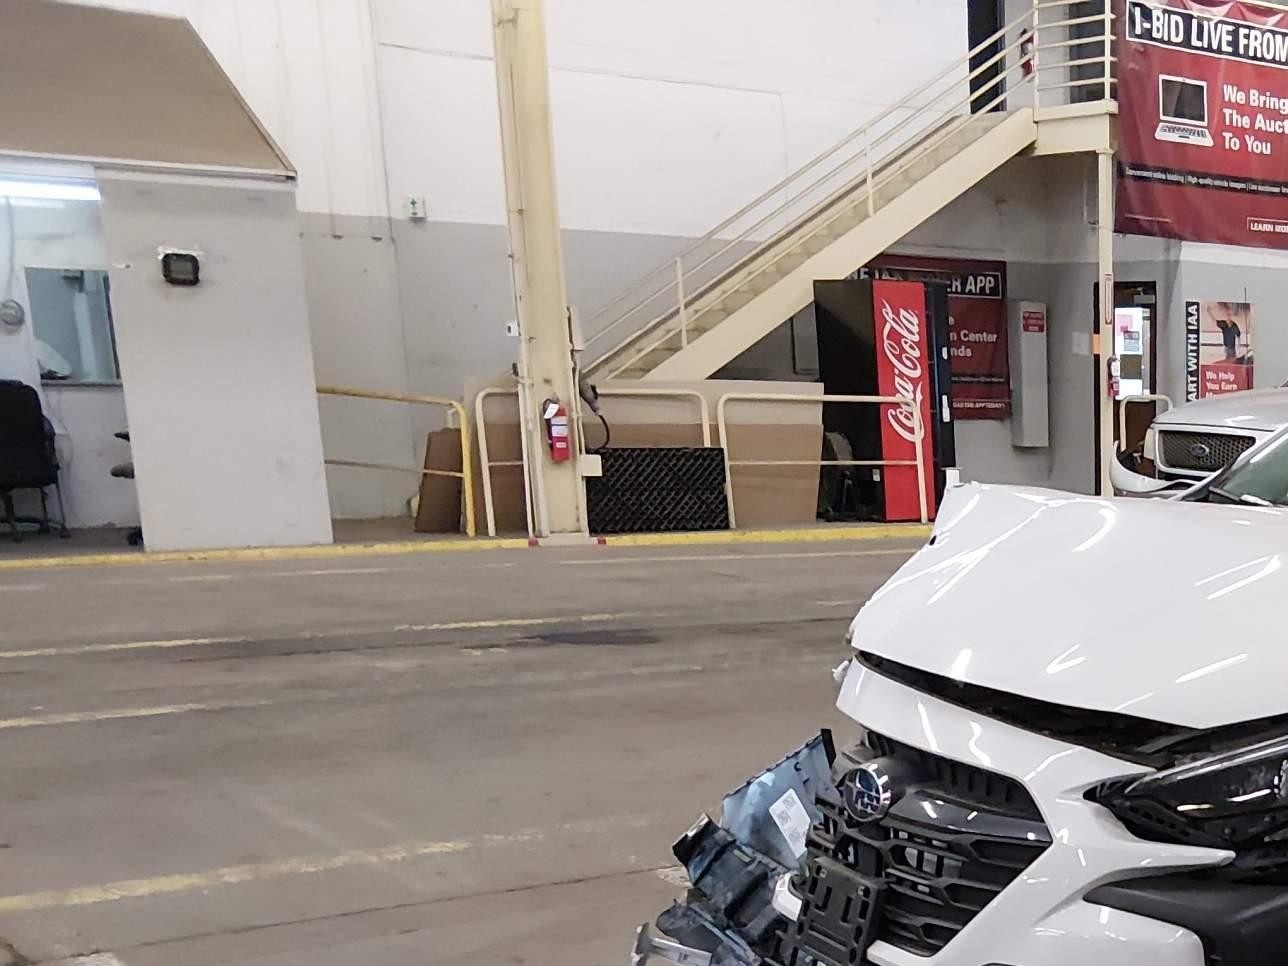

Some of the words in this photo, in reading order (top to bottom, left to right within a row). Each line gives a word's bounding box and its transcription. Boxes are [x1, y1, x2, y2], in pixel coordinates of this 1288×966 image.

[1134, 6, 1184, 43] I-BID
[1191, 18, 1235, 53] LIVE
[1223, 84, 1246, 104] We
[1249, 88, 1288, 115] Bring
[1222, 108, 1250, 128] The
[1222, 131, 1240, 150] To
[1244, 134, 1271, 154] You
[965, 275, 995, 294] APP
[1187, 304, 1198, 330] IAA
[960, 330, 998, 343] Center
[950, 345, 972, 357] nds
[1187, 333, 1198, 371] WITH
[1205, 371, 1217, 380] We
[1218, 372, 1235, 381] Help
[1206, 381, 1219, 390] You
[1221, 382, 1238, 390] Earn
[1187, 374, 1198, 401] ART
